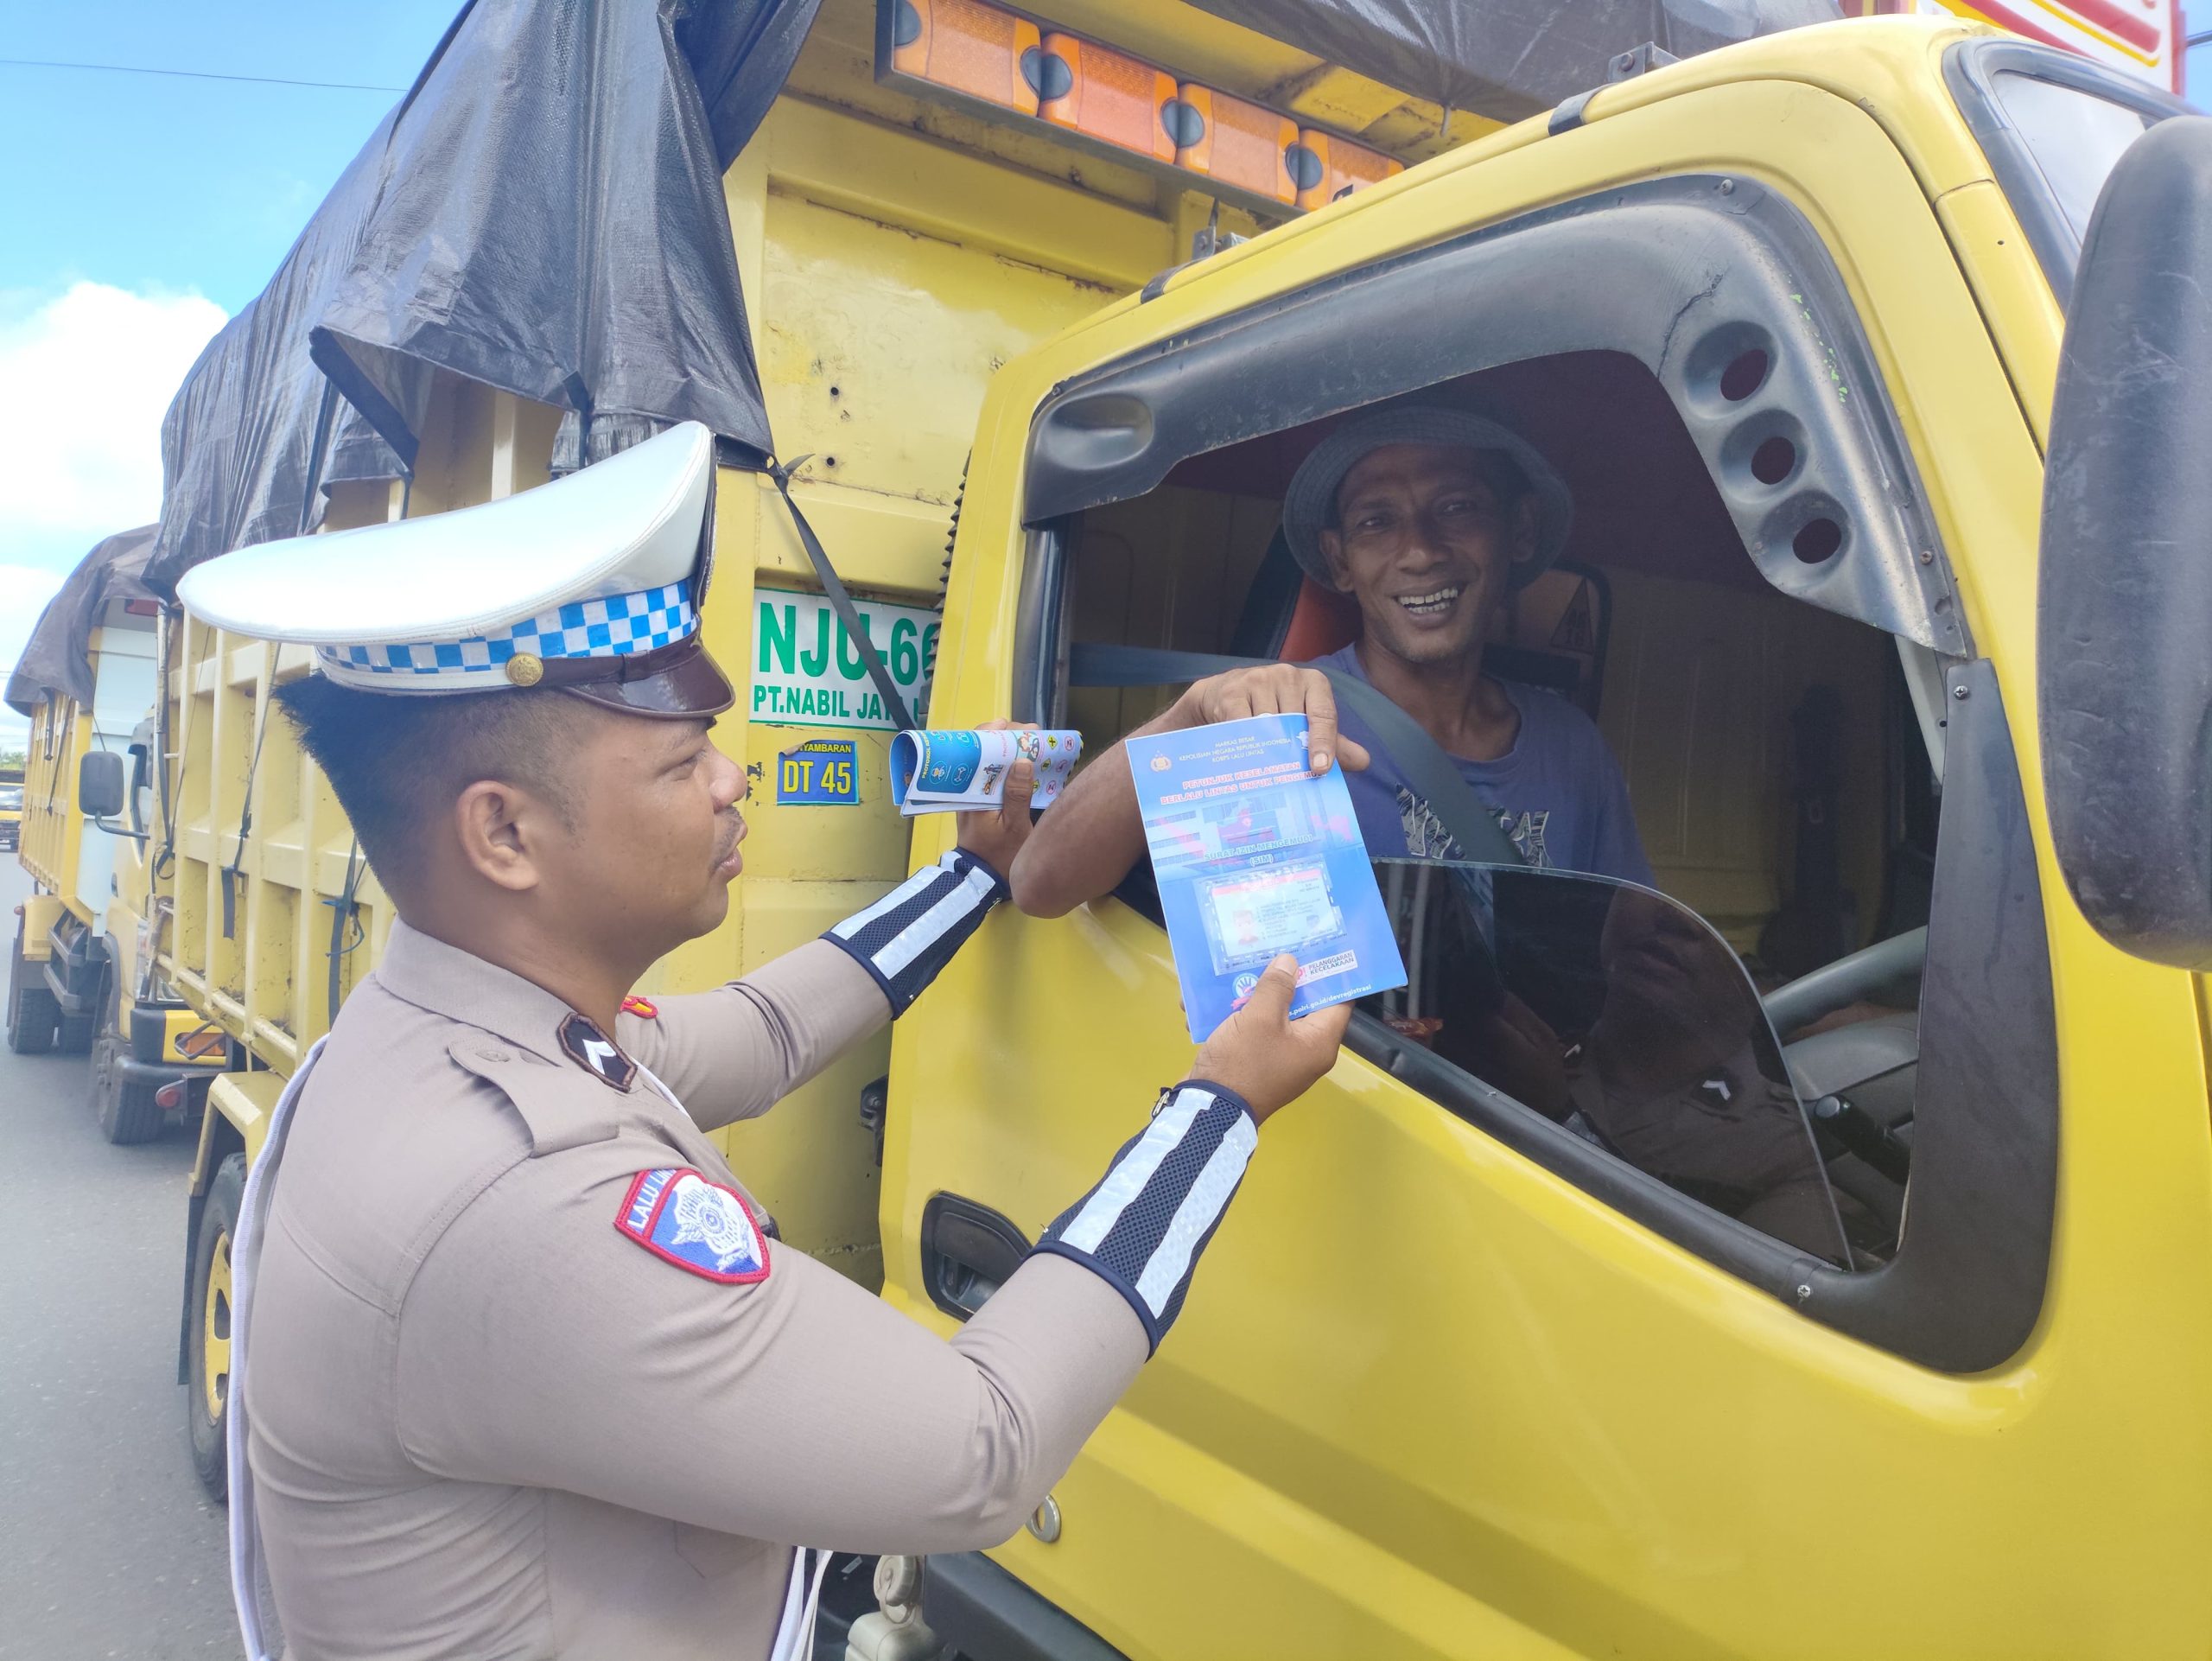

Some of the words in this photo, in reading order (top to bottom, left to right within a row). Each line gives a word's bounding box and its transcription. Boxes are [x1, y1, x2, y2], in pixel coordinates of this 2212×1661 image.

[753, 684, 850, 718] PT.NABIL
[800, 743, 852, 754] YAMBARAN
[784, 760, 814, 793] DT
[820, 761, 851, 794] 45
[1160, 790, 1204, 805] BERLALU
[1205, 784, 1238, 798] LINTAS
[1239, 778, 1273, 791] UNTUK
[1274, 770, 1327, 784] PENGEMU
[1182, 773, 1235, 790] PETUNJUK
[1235, 761, 1301, 780] KESELAMATAN
[1204, 849, 1235, 861] SURAT
[1257, 833, 1313, 852] MENGEMUDI
[1249, 853, 1274, 867] (SIM)
[1308, 951, 1353, 971] PELANGGARAN
[1310, 958, 1355, 976] KECELAKAAN
[1288, 983, 1372, 1017] s.polri.go.id/devregistrasi
[626, 1182, 659, 1229] LALU
